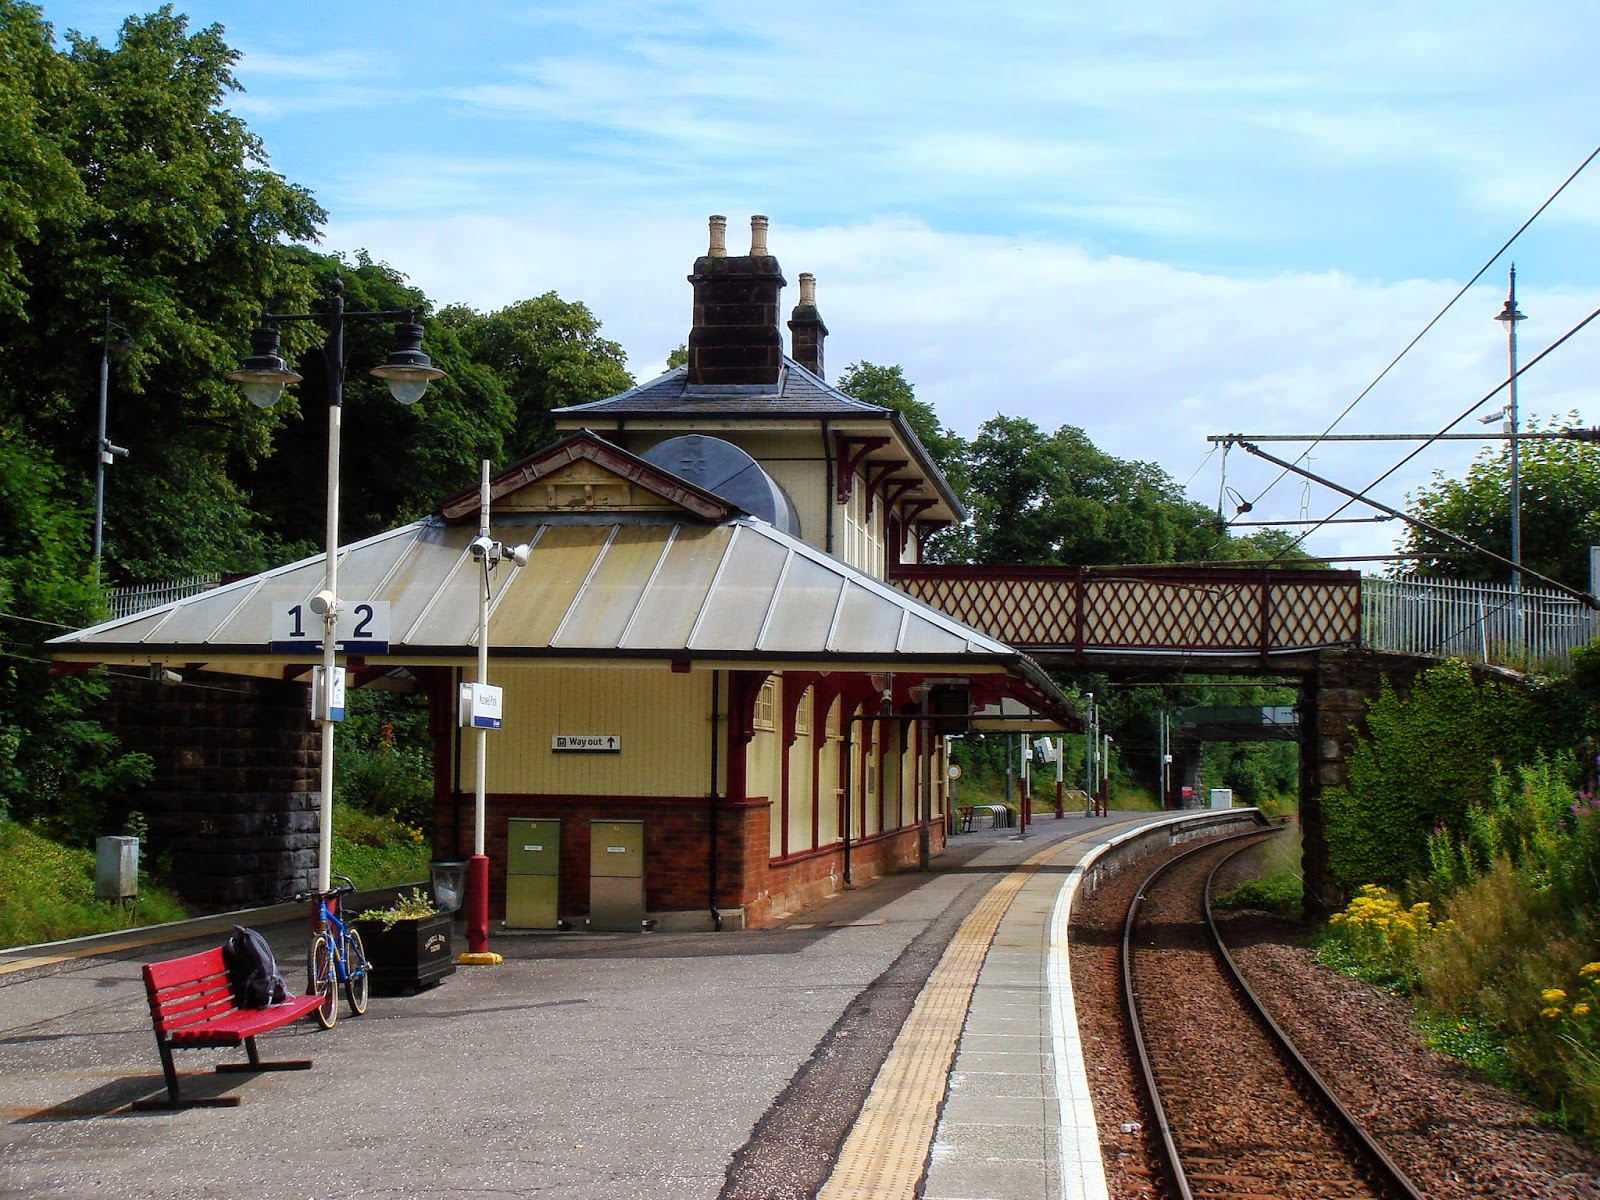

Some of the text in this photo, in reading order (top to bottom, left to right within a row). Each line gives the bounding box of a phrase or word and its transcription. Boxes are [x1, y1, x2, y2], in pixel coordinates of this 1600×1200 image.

[288, 604, 374, 638] 1 2
[569, 737, 603, 747] Way out
